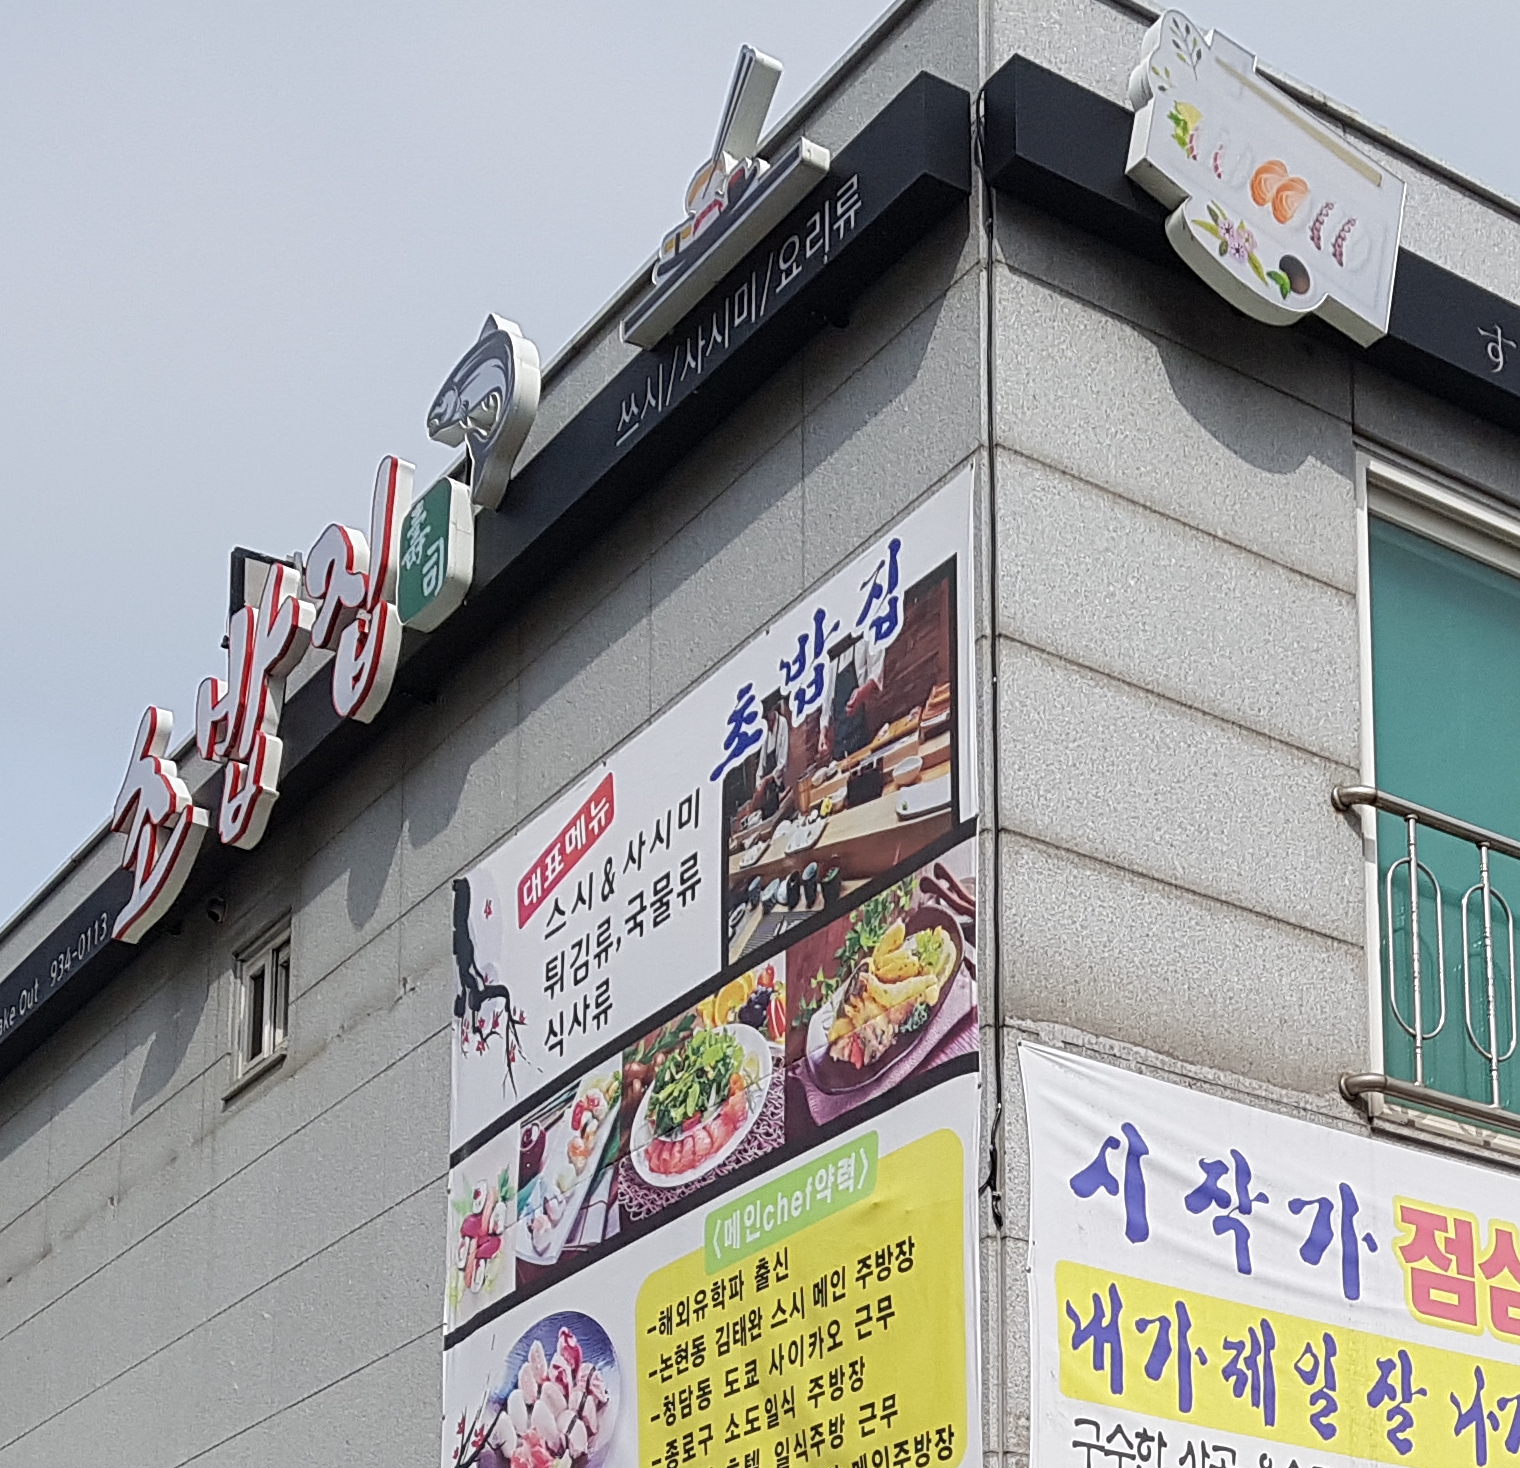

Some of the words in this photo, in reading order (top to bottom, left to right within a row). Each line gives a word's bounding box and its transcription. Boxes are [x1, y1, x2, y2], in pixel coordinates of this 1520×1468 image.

[111, 455, 404, 942] 초밥집
[710, 538, 902, 782] 초밥집
[522, 796, 612, 908] 대표메뉴
[20, 978, 39, 1016] Out
[50, 912, 108, 987] 934-0113
[544, 978, 613, 1058] 식사류
[1069, 1122, 1378, 1300] 시작가
[715, 1307, 763, 1357] 김태완
[770, 1287, 806, 1329] 스시
[812, 1266, 847, 1309] 메인
[855, 1235, 916, 1290] 주방장
[755, 1246, 790, 1288] 출신
[768, 1320, 844, 1377] 사이카오
[855, 1295, 896, 1339] 근무
[724, 1386, 797, 1445] 소도일식
[807, 1356, 866, 1410] 주방장
[858, 1394, 899, 1437] 근무
[1367, 1349, 1428, 1456] 잘
